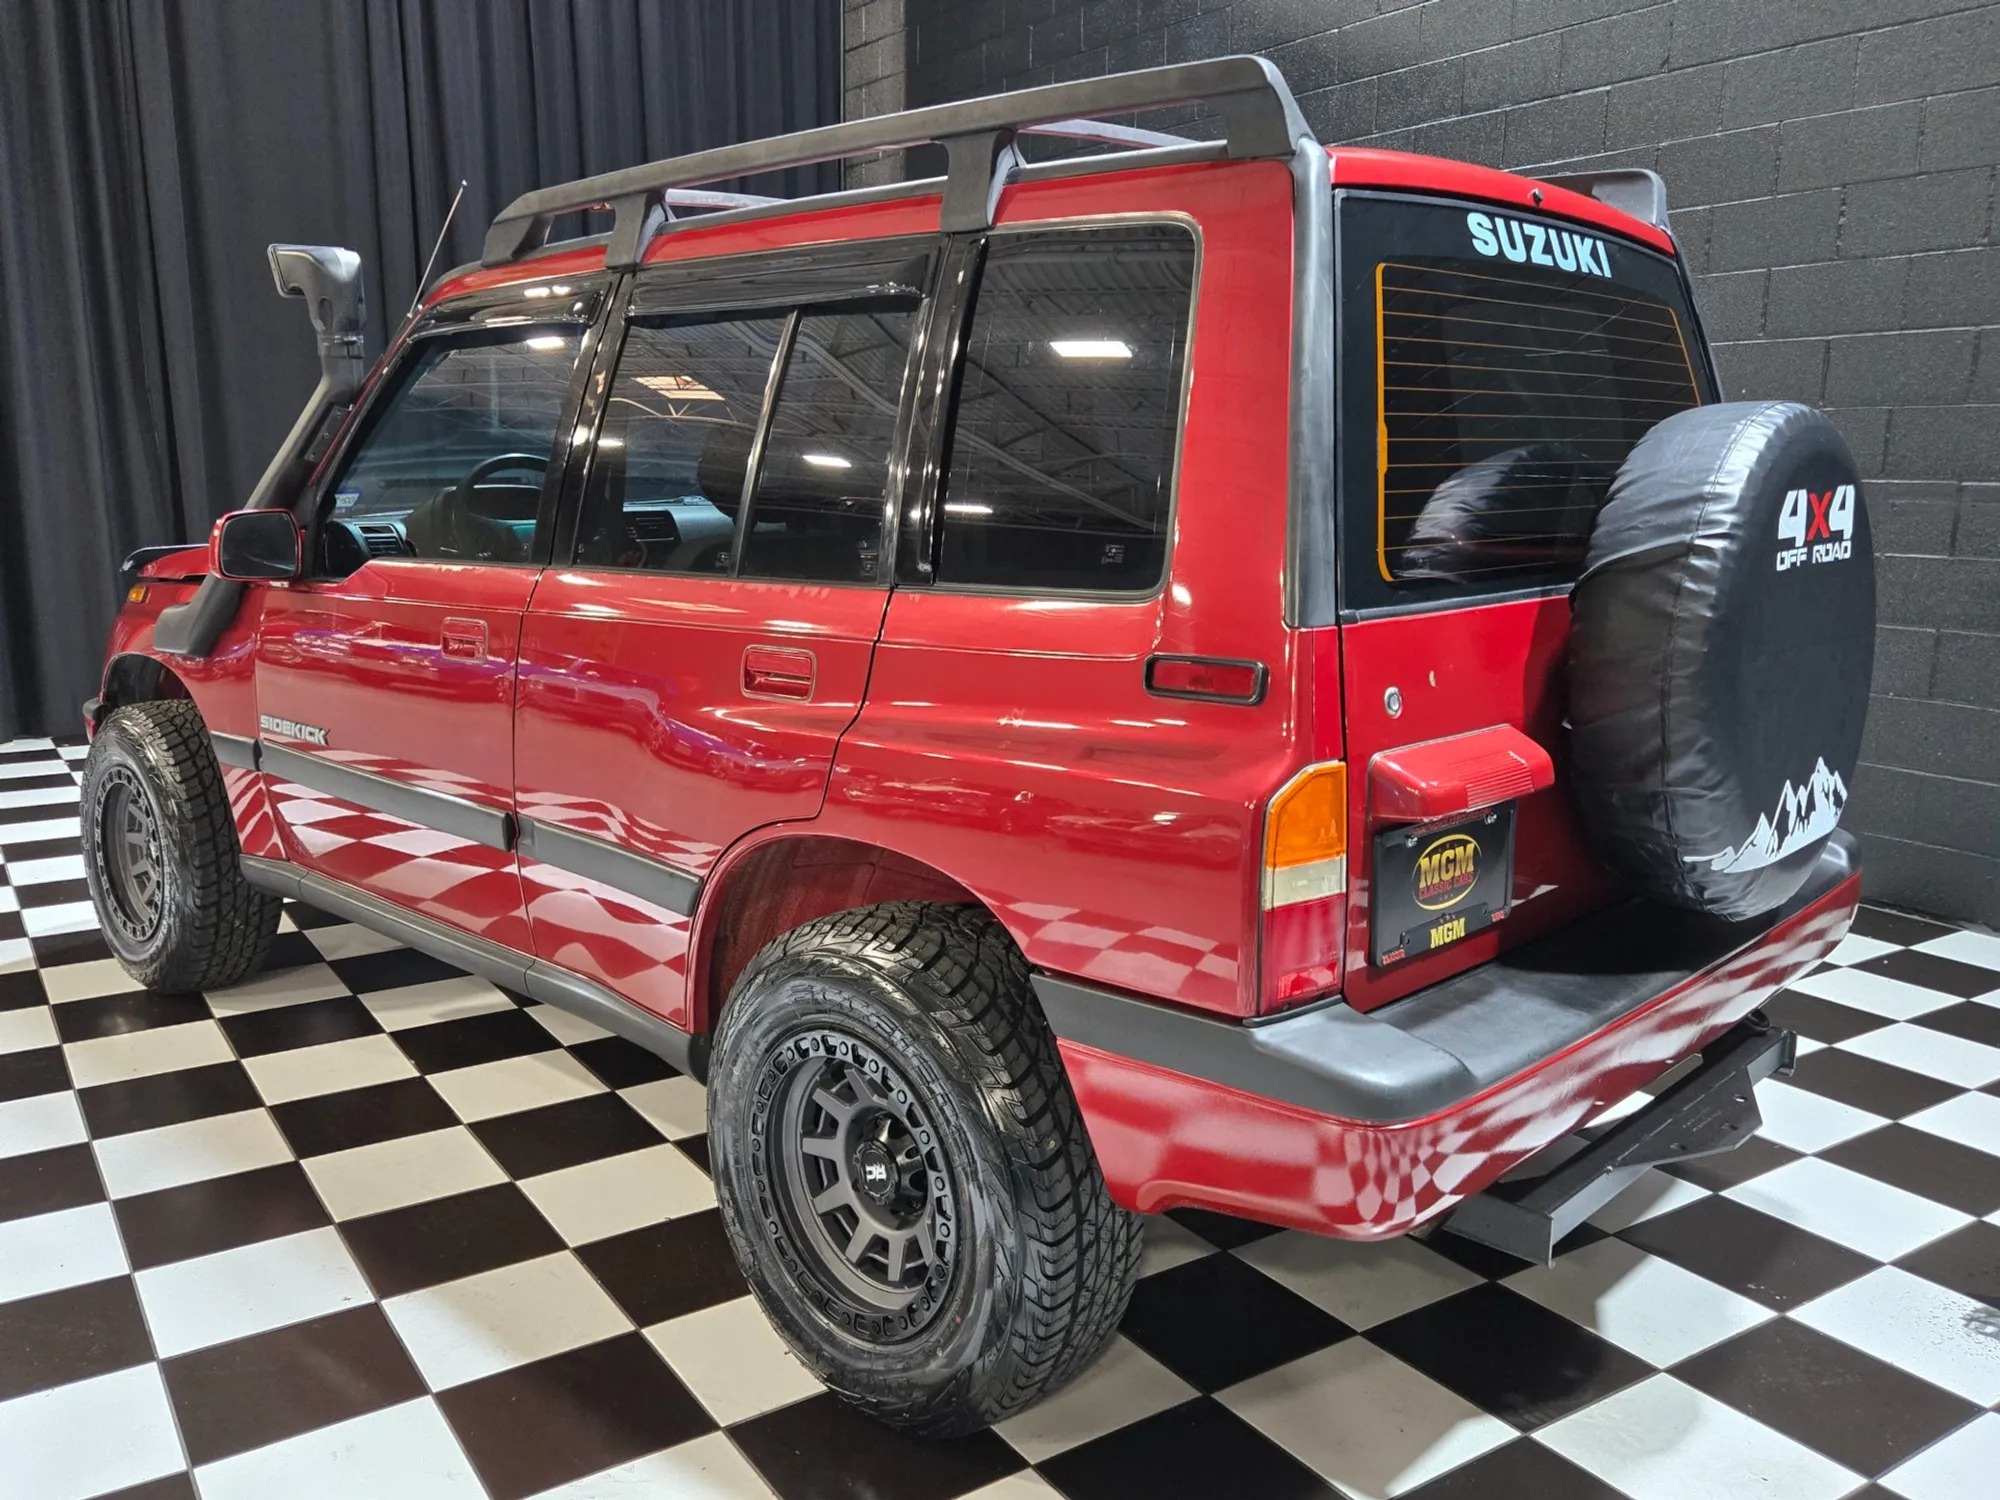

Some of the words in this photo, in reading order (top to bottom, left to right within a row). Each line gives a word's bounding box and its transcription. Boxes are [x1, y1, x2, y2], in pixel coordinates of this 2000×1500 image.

[1467, 212, 1612, 278] SUZUKI
[1776, 547, 1808, 571] OFF
[1811, 540, 1851, 564] ROAD
[260, 713, 331, 746] SIDEKICK
[1419, 843, 1475, 888] MGM
[1430, 917, 1466, 949] MGM
